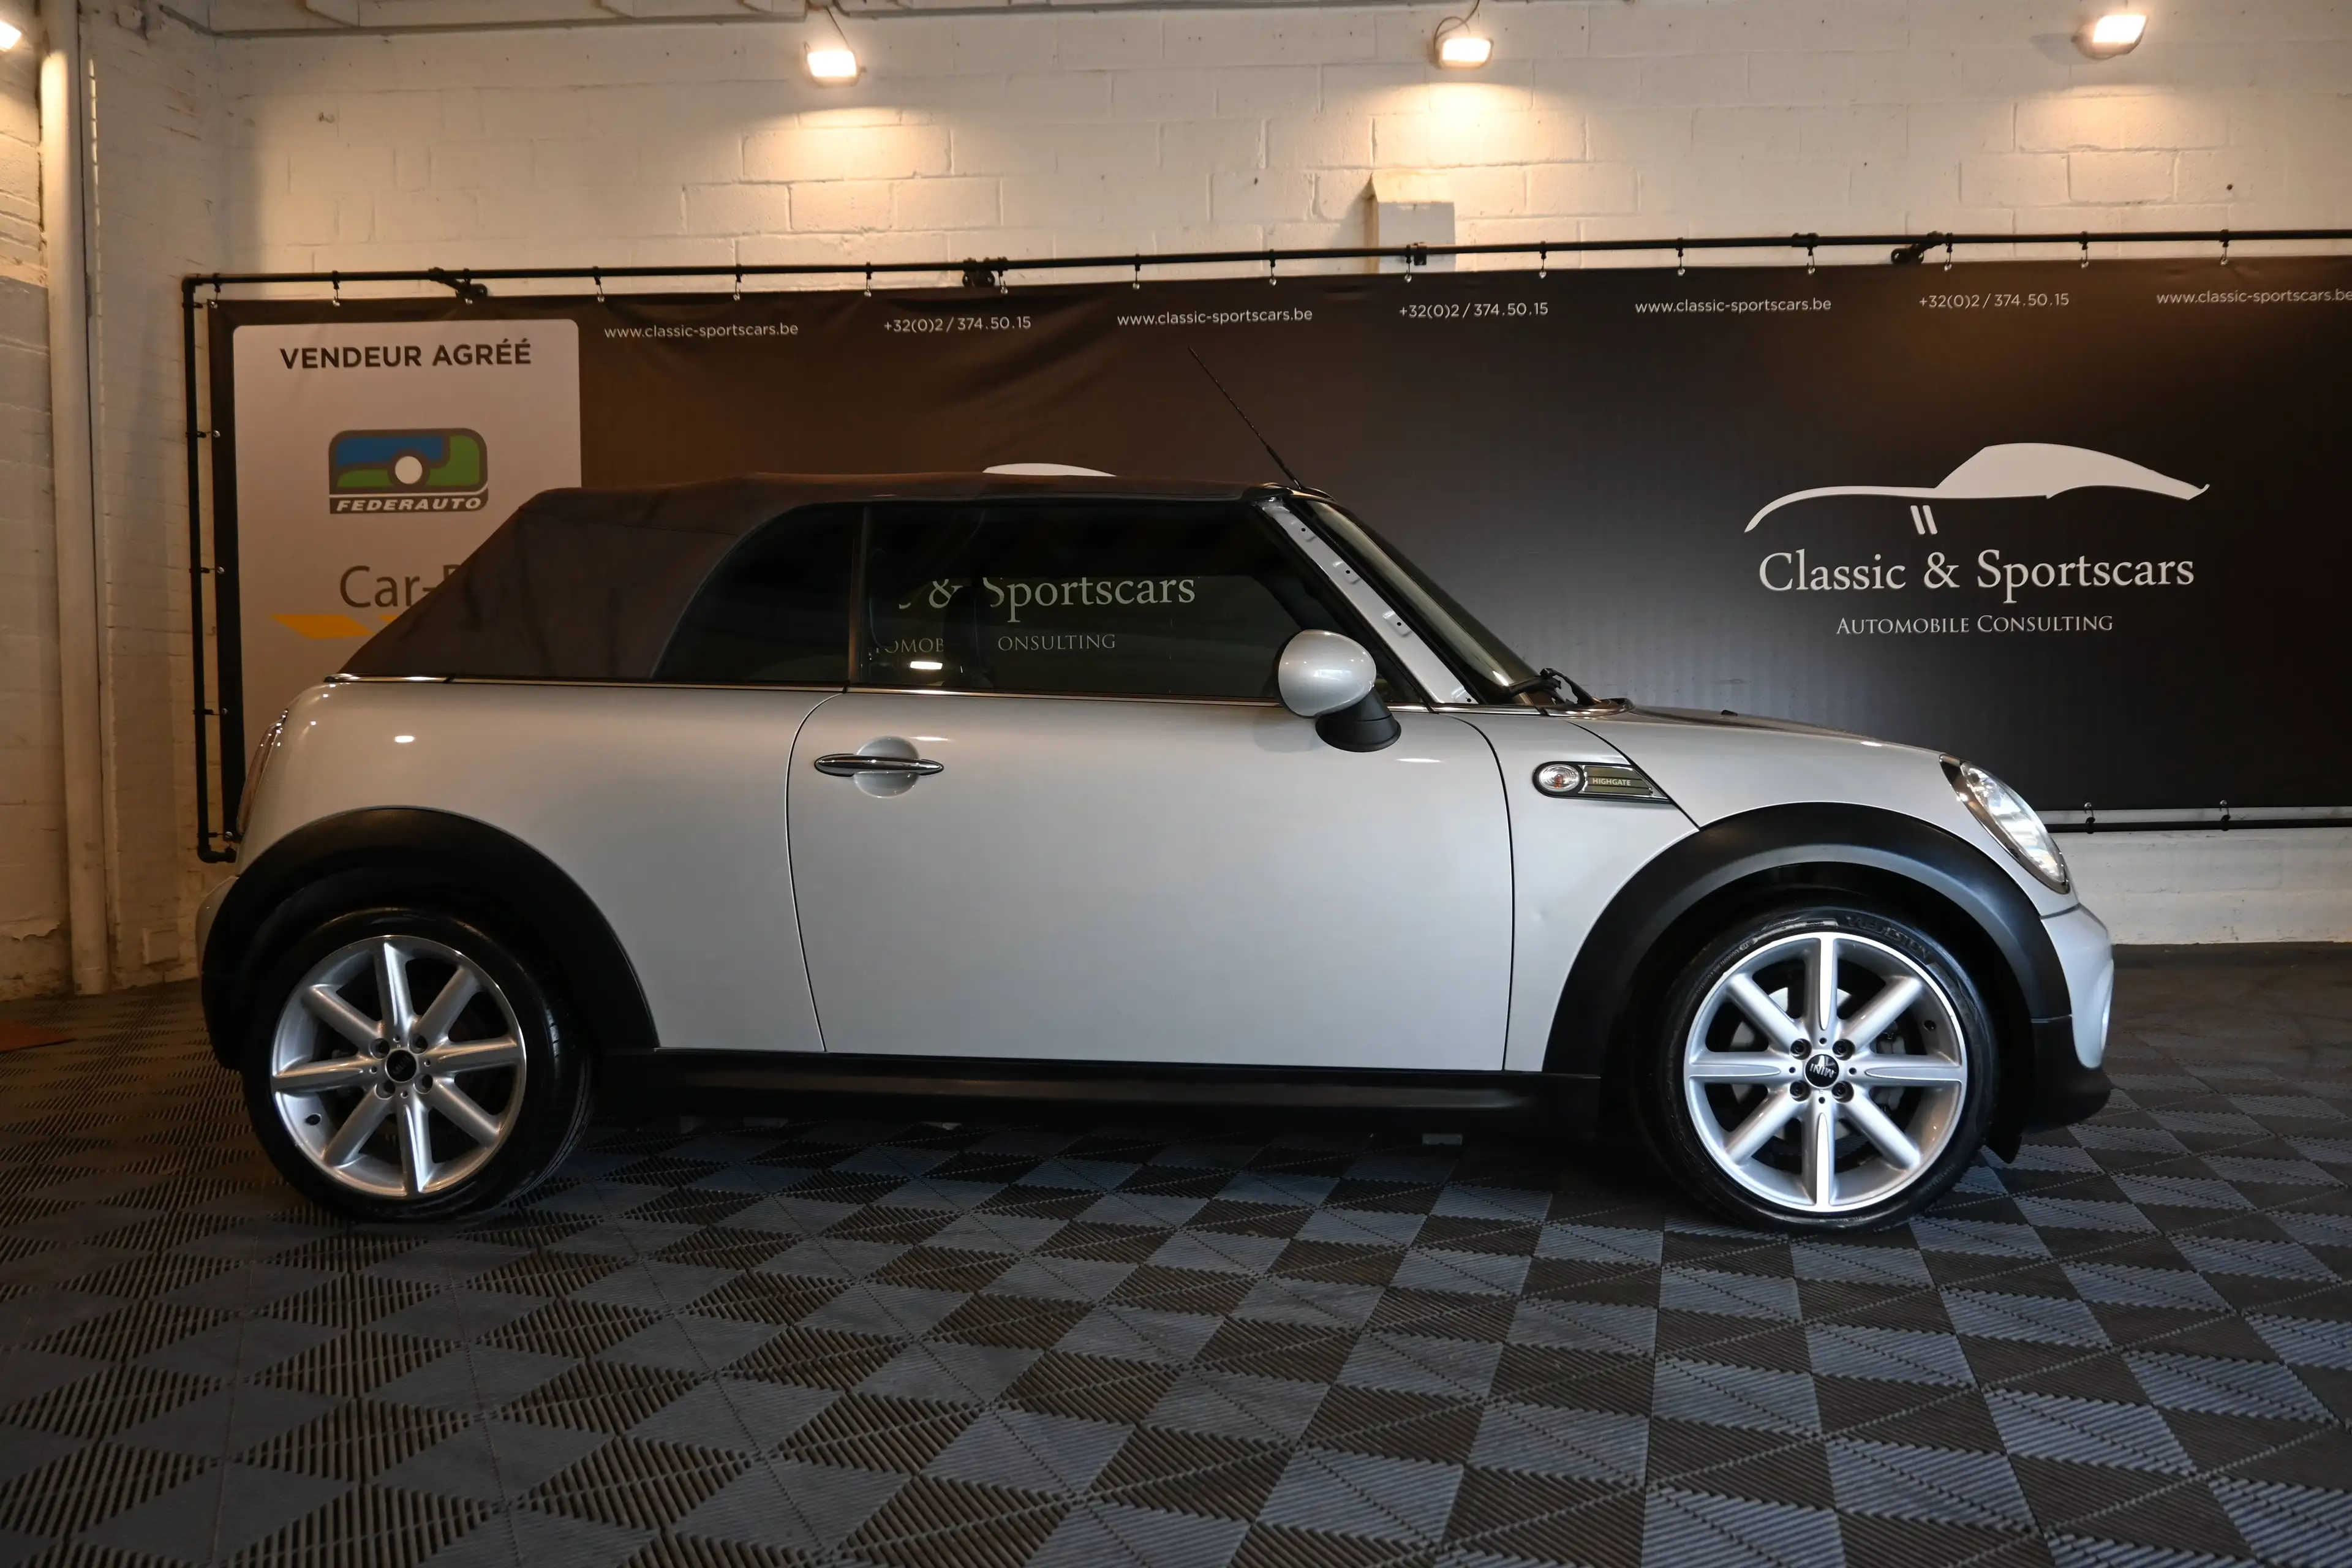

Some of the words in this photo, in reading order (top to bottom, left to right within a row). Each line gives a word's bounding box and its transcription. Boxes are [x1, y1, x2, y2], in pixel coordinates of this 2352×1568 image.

[2156, 288, 2352, 305] www.classic-sportscars.be
[1635, 297, 1831, 314] www.classic-sportscars.be
[1117, 307, 1313, 325] www.classic-sportscars.be
[604, 322, 799, 339] www.classic-sportscars.be
[280, 345, 422, 369] VENDEUR
[432, 337, 531, 366] AGRÉÉ
[336, 497, 482, 511] FEDERAUTO
[1759, 548, 1906, 591] Classic
[1923, 551, 1960, 589] &
[1977, 549, 2194, 603] Sportscars
[1836, 617, 1969, 634] AUTOMOBILE
[1977, 615, 2113, 632] CONSULTING
[998, 634, 1115, 651] ONSULTING
[1809, 1063, 1836, 1078] MINI
